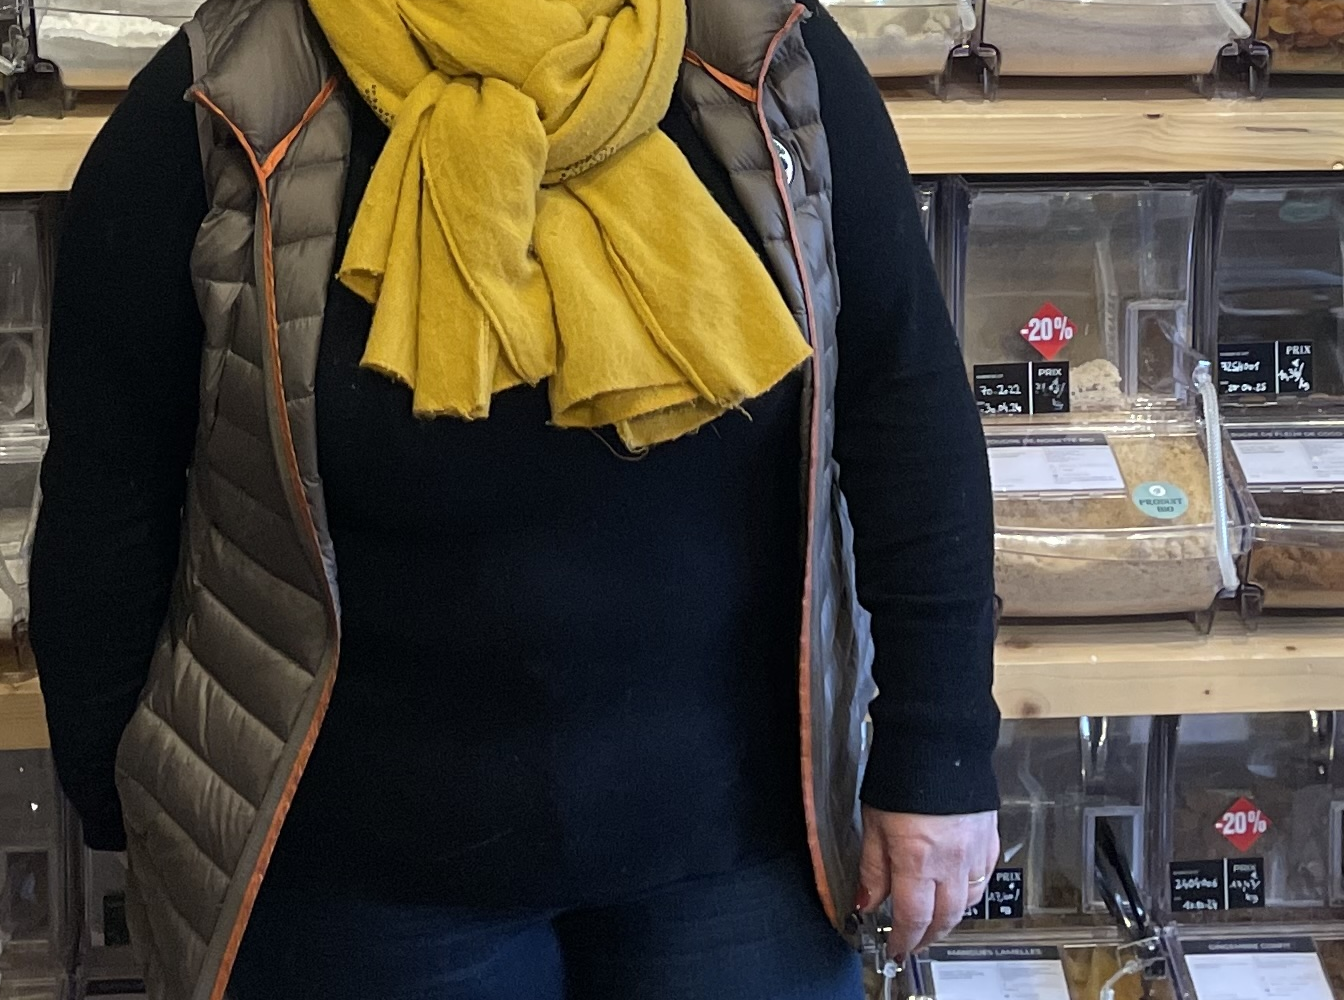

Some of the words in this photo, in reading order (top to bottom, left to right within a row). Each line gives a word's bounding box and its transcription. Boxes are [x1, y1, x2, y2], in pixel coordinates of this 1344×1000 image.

[1021, 316, 1075, 342] -20%
[1286, 345, 1311, 355] PRIX
[1038, 368, 1062, 376] PRIX
[1214, 809, 1267, 834] -20%
[995, 872, 1021, 882] PRIX
